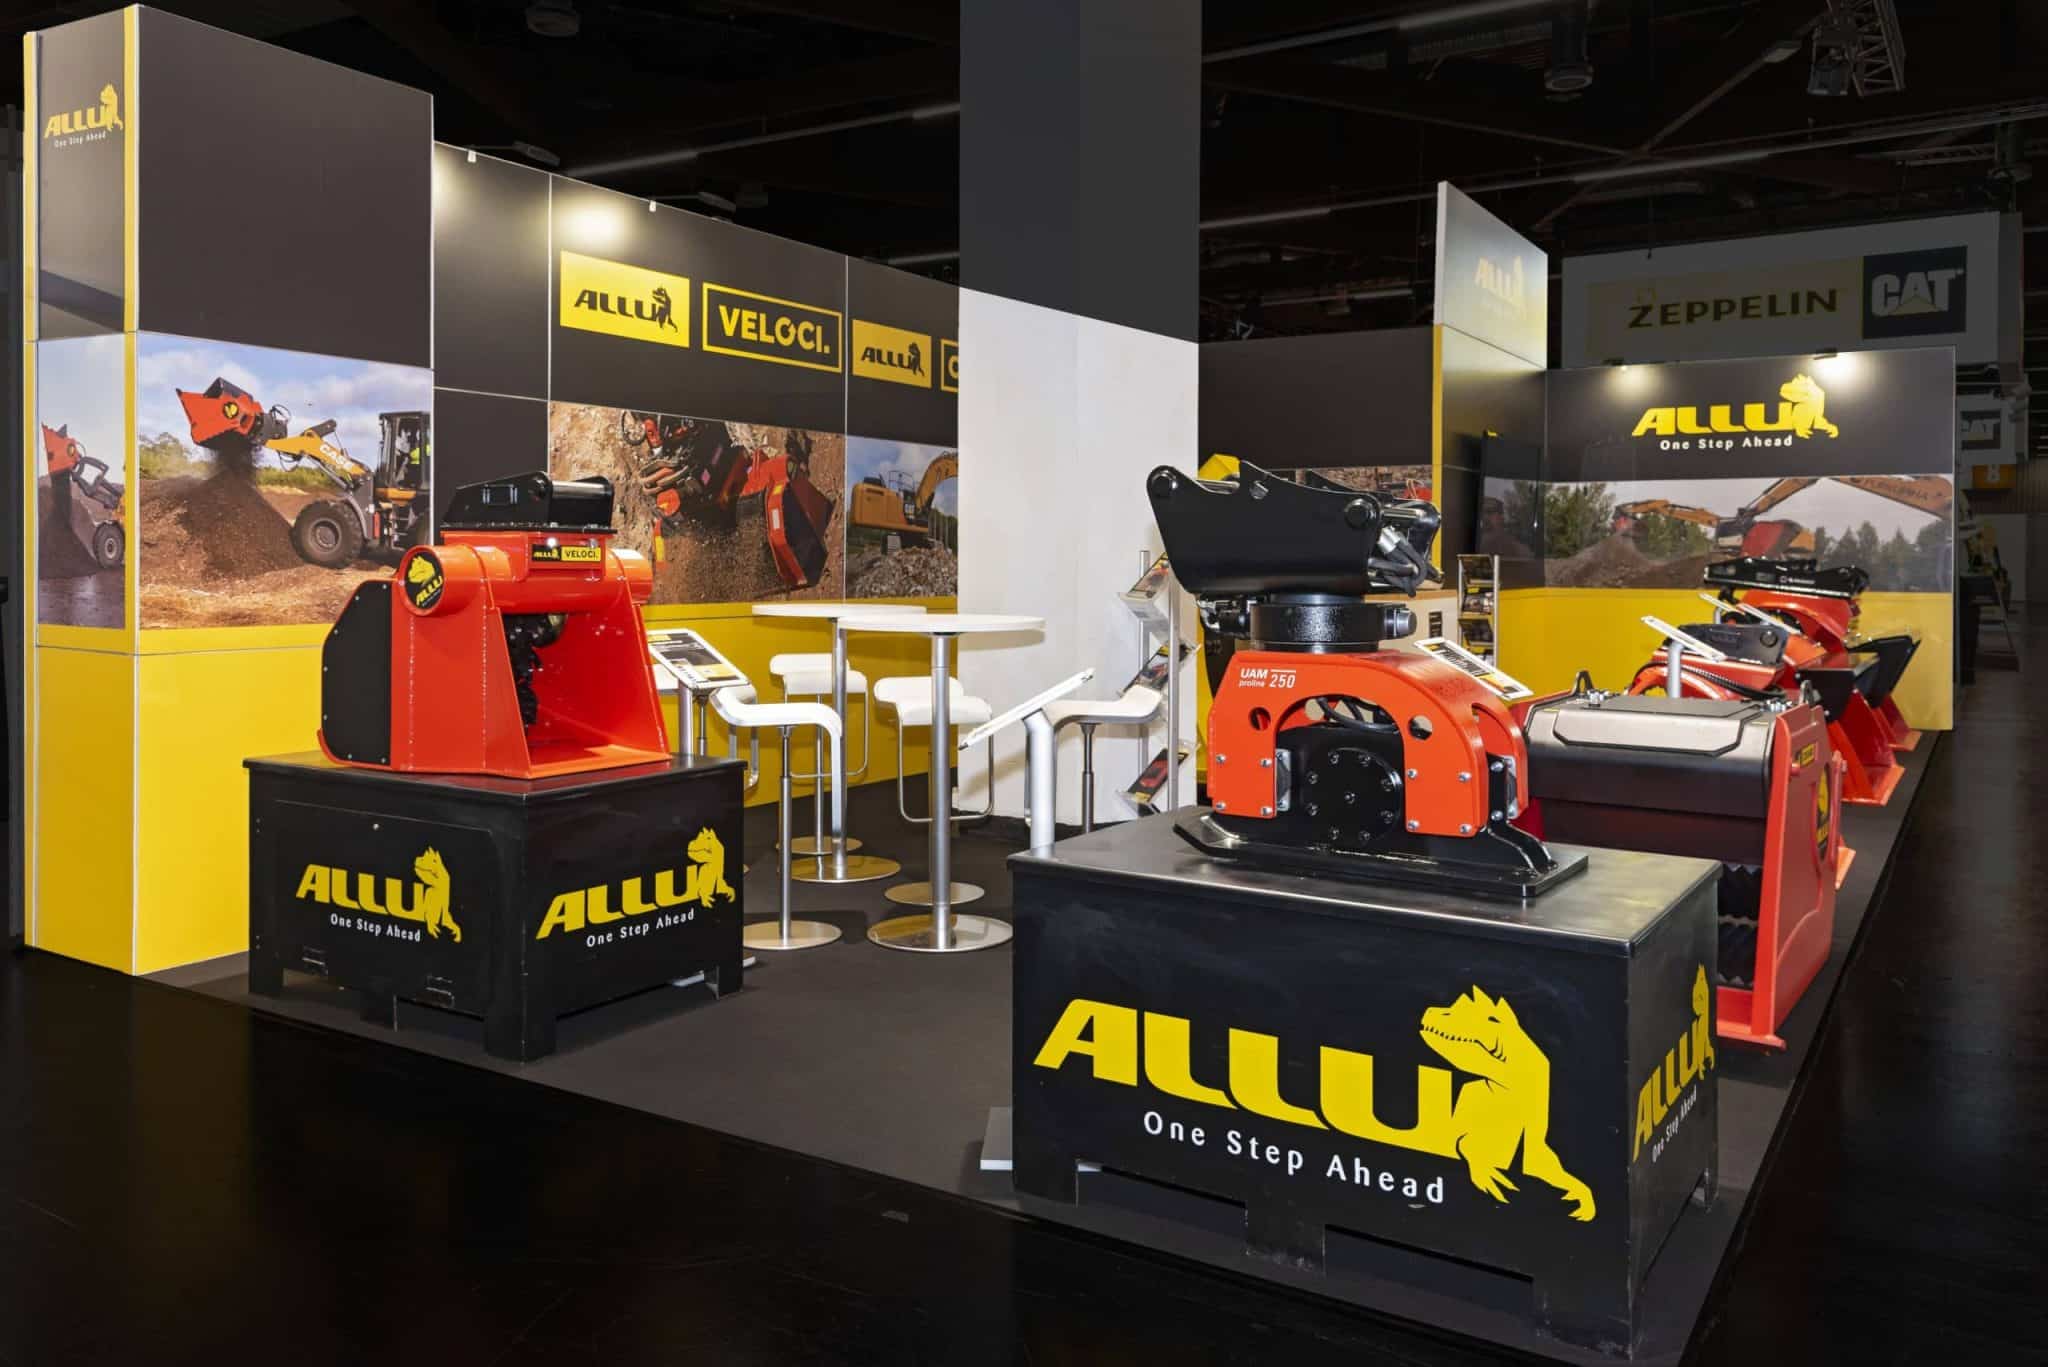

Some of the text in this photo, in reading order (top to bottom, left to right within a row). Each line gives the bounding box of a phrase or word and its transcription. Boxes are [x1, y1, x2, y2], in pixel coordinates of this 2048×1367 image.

[44, 104, 106, 138] ALLU
[574, 288, 657, 322] ALLU
[1628, 289, 1837, 328] ZEPPELIN
[1871, 268, 1957, 318] CAT
[861, 346, 912, 370] ALLU
[1632, 401, 1796, 437] ALLU
[1660, 434, 1793, 451] One Step Ahead
[416, 576, 443, 606] ALLU
[1240, 667, 1296, 688] UAM 250
[296, 864, 426, 922] ALLU
[536, 864, 701, 940] ALLU
[330, 912, 421, 942] One Step Ahead
[586, 907, 695, 948] One Step Ahead
[1033, 998, 1463, 1160] ALLU
[1632, 1018, 1703, 1163] ALLU
[1143, 1110, 1444, 1204] One Step Ahead
